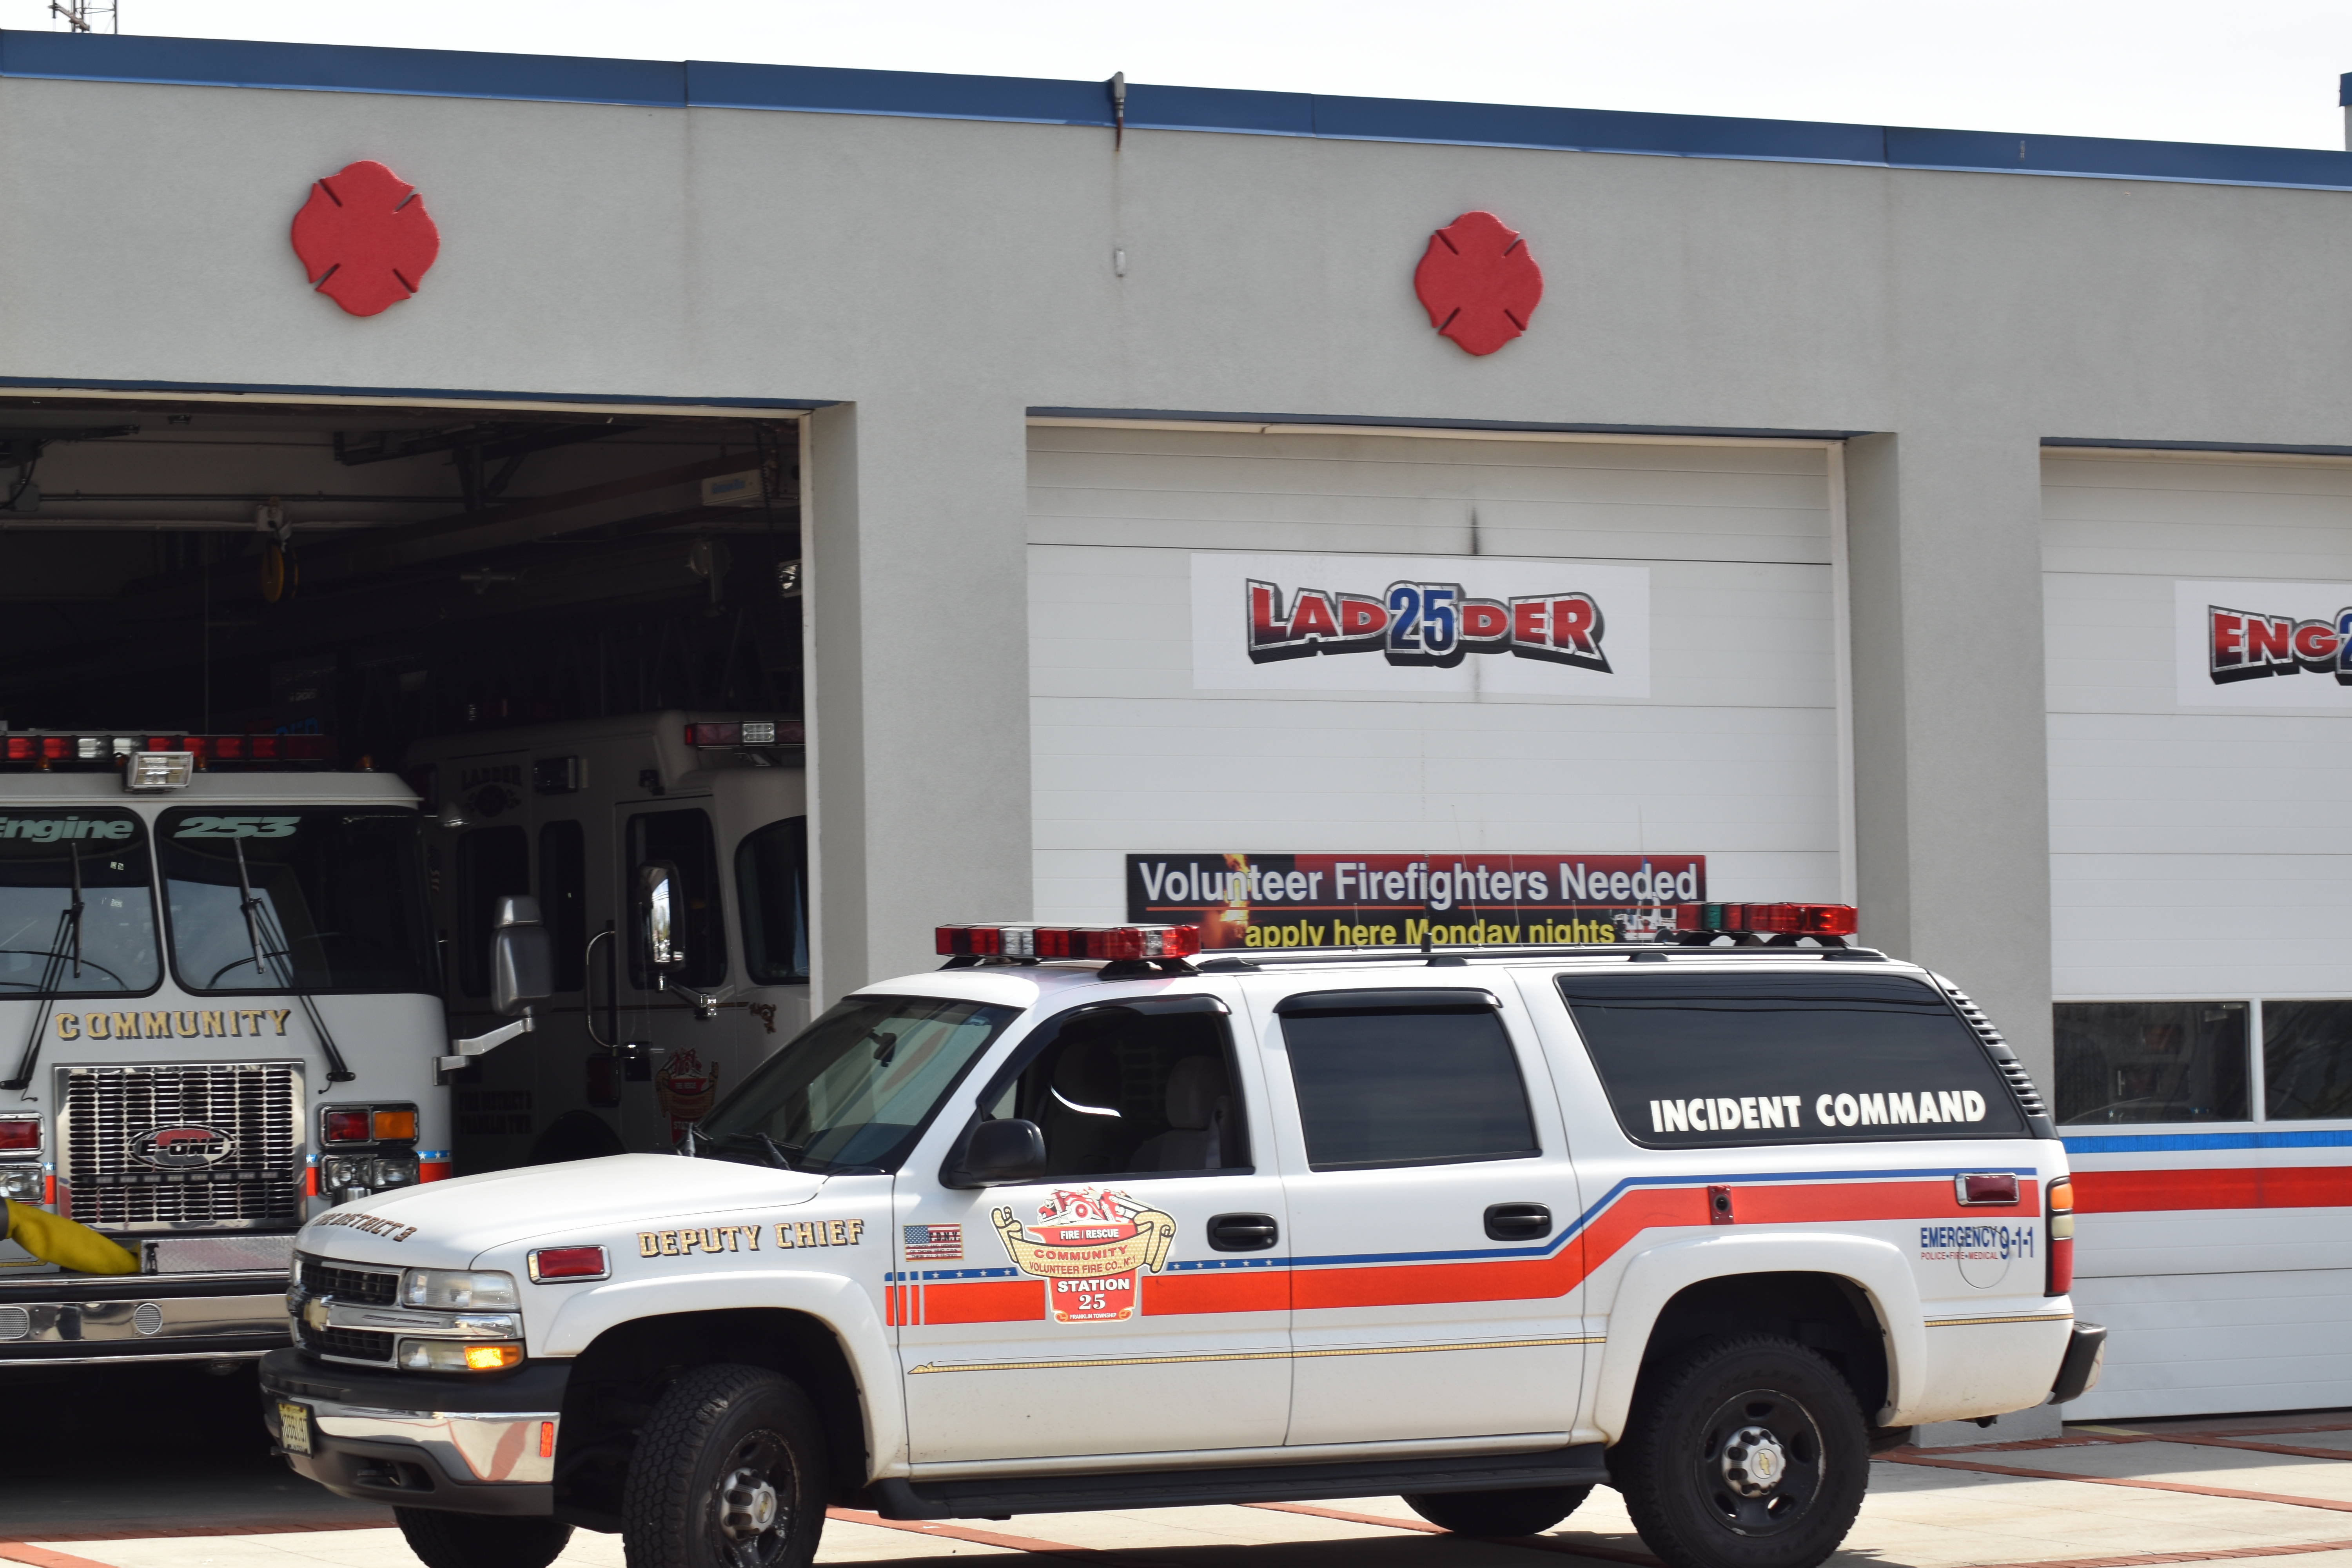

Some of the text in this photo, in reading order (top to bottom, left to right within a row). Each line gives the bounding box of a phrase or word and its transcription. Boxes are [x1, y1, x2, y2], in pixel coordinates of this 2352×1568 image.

[173, 817, 301, 838] 253
[1139, 862, 1697, 910] Volunteer Firefighters Needed
[1245, 918, 1615, 947] apply here Monday nights
[55, 1009, 291, 1041] COMMUNITY
[1650, 1090, 1986, 1132] INCIDENT COMMAND
[328, 1213, 405, 1237] DISTRICT
[393, 1226, 417, 1242] 3
[637, 1218, 864, 1258] DEPUTY CHIEF
[1060, 1230, 1080, 1240] FIRE
[1085, 1229, 1119, 1239] RESCUE
[1920, 1226, 1997, 1248] EMERGENCY
[1034, 1245, 1128, 1261] COMMUNITY
[1029, 1261, 1080, 1274] VOLUNTEER
[1082, 1263, 1103, 1274] FIRE
[1057, 1278, 1129, 1293] STATION
[1078, 1293, 1106, 1310] 25
